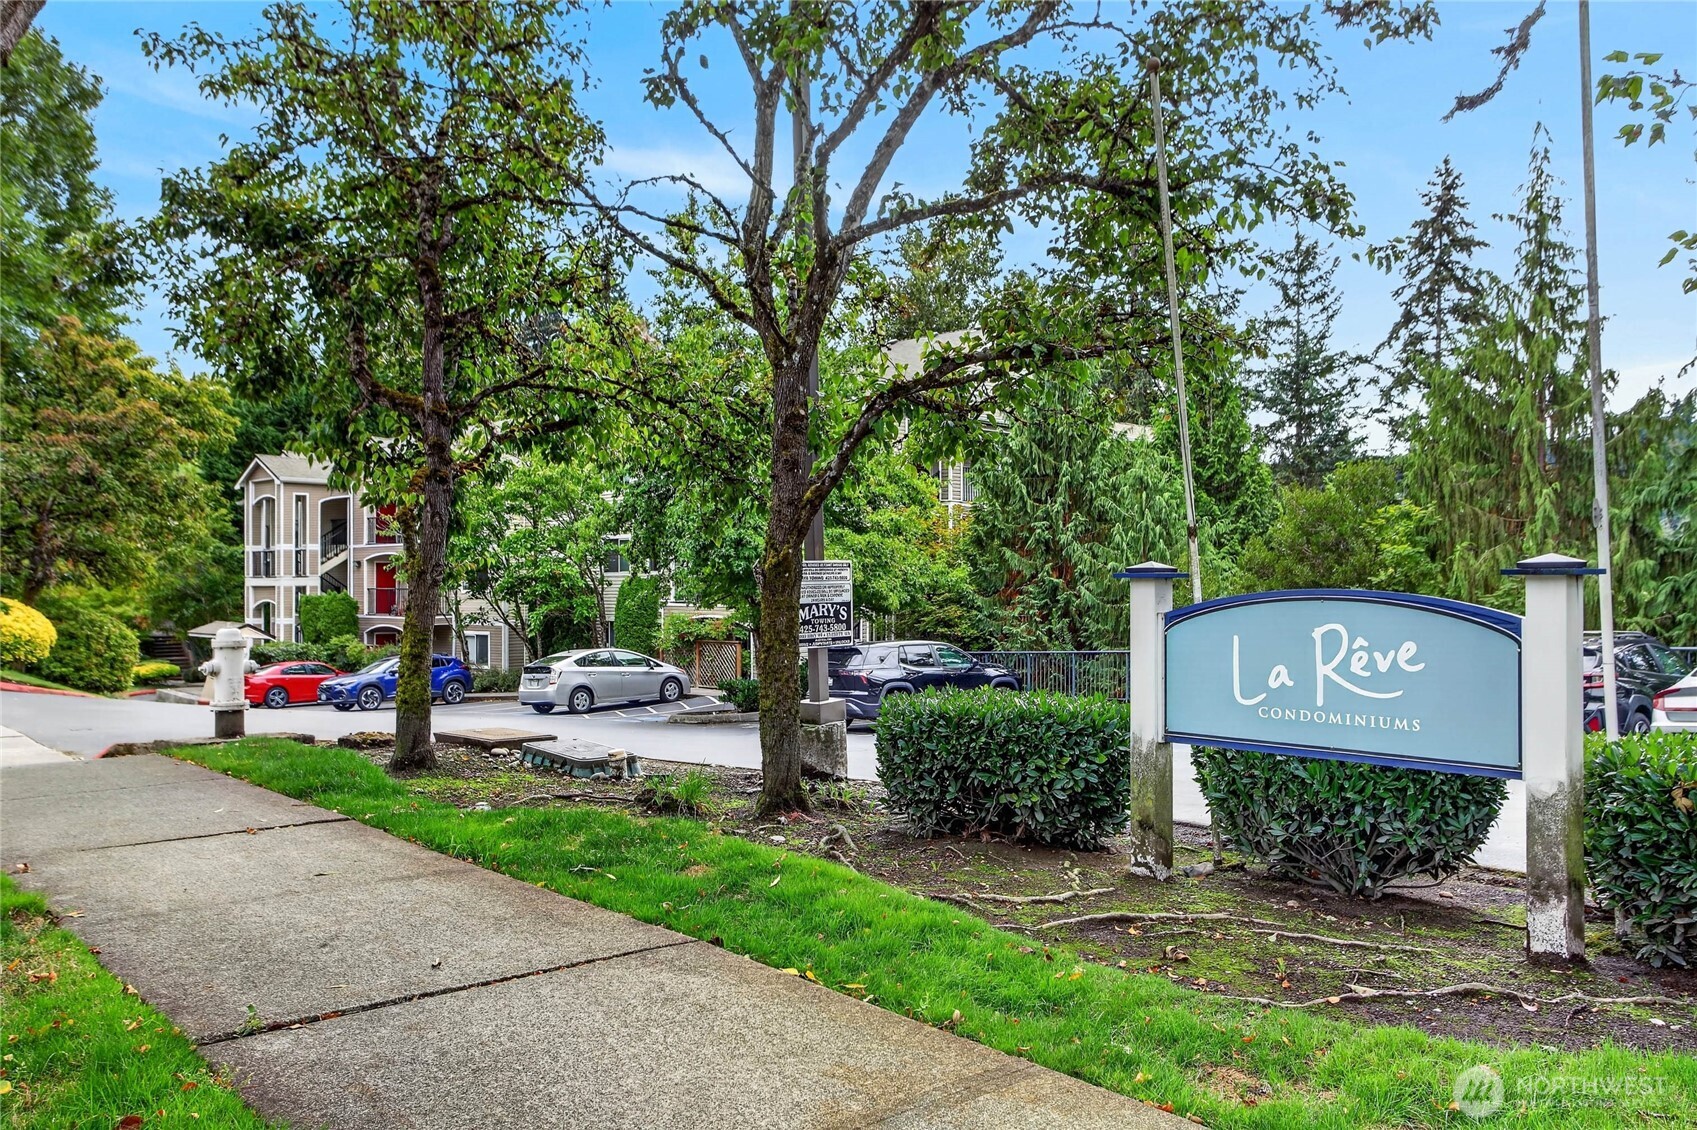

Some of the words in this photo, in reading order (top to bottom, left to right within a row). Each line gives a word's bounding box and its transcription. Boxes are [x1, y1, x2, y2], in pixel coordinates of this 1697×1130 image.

[798, 603, 848, 623] MARY'S
[799, 623, 847, 634] 425-743-5800
[1232, 634, 1294, 706] La
[1311, 623, 1426, 707] Rêve
[1258, 706, 1421, 732] CONDOMINIUMS
